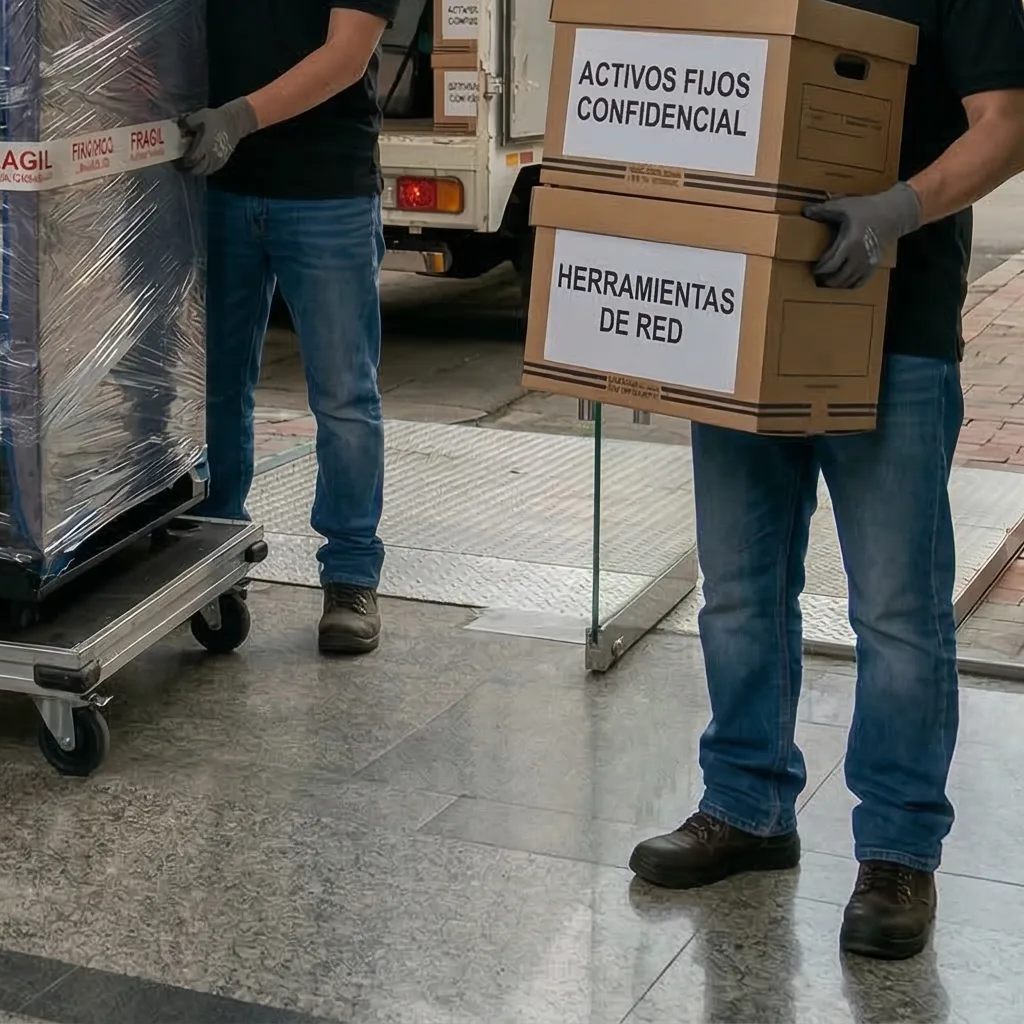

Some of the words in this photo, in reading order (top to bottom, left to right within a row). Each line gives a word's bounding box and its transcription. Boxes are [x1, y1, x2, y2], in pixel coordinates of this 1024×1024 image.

[578, 60, 676, 93] ACTIVOS
[683, 68, 751, 99] FIJOS
[577, 95, 748, 137] CONFIDENCIAL
[558, 262, 735, 316] HERRAMIENTAS
[600, 307, 629, 336] DE
[636, 312, 683, 345] RED
